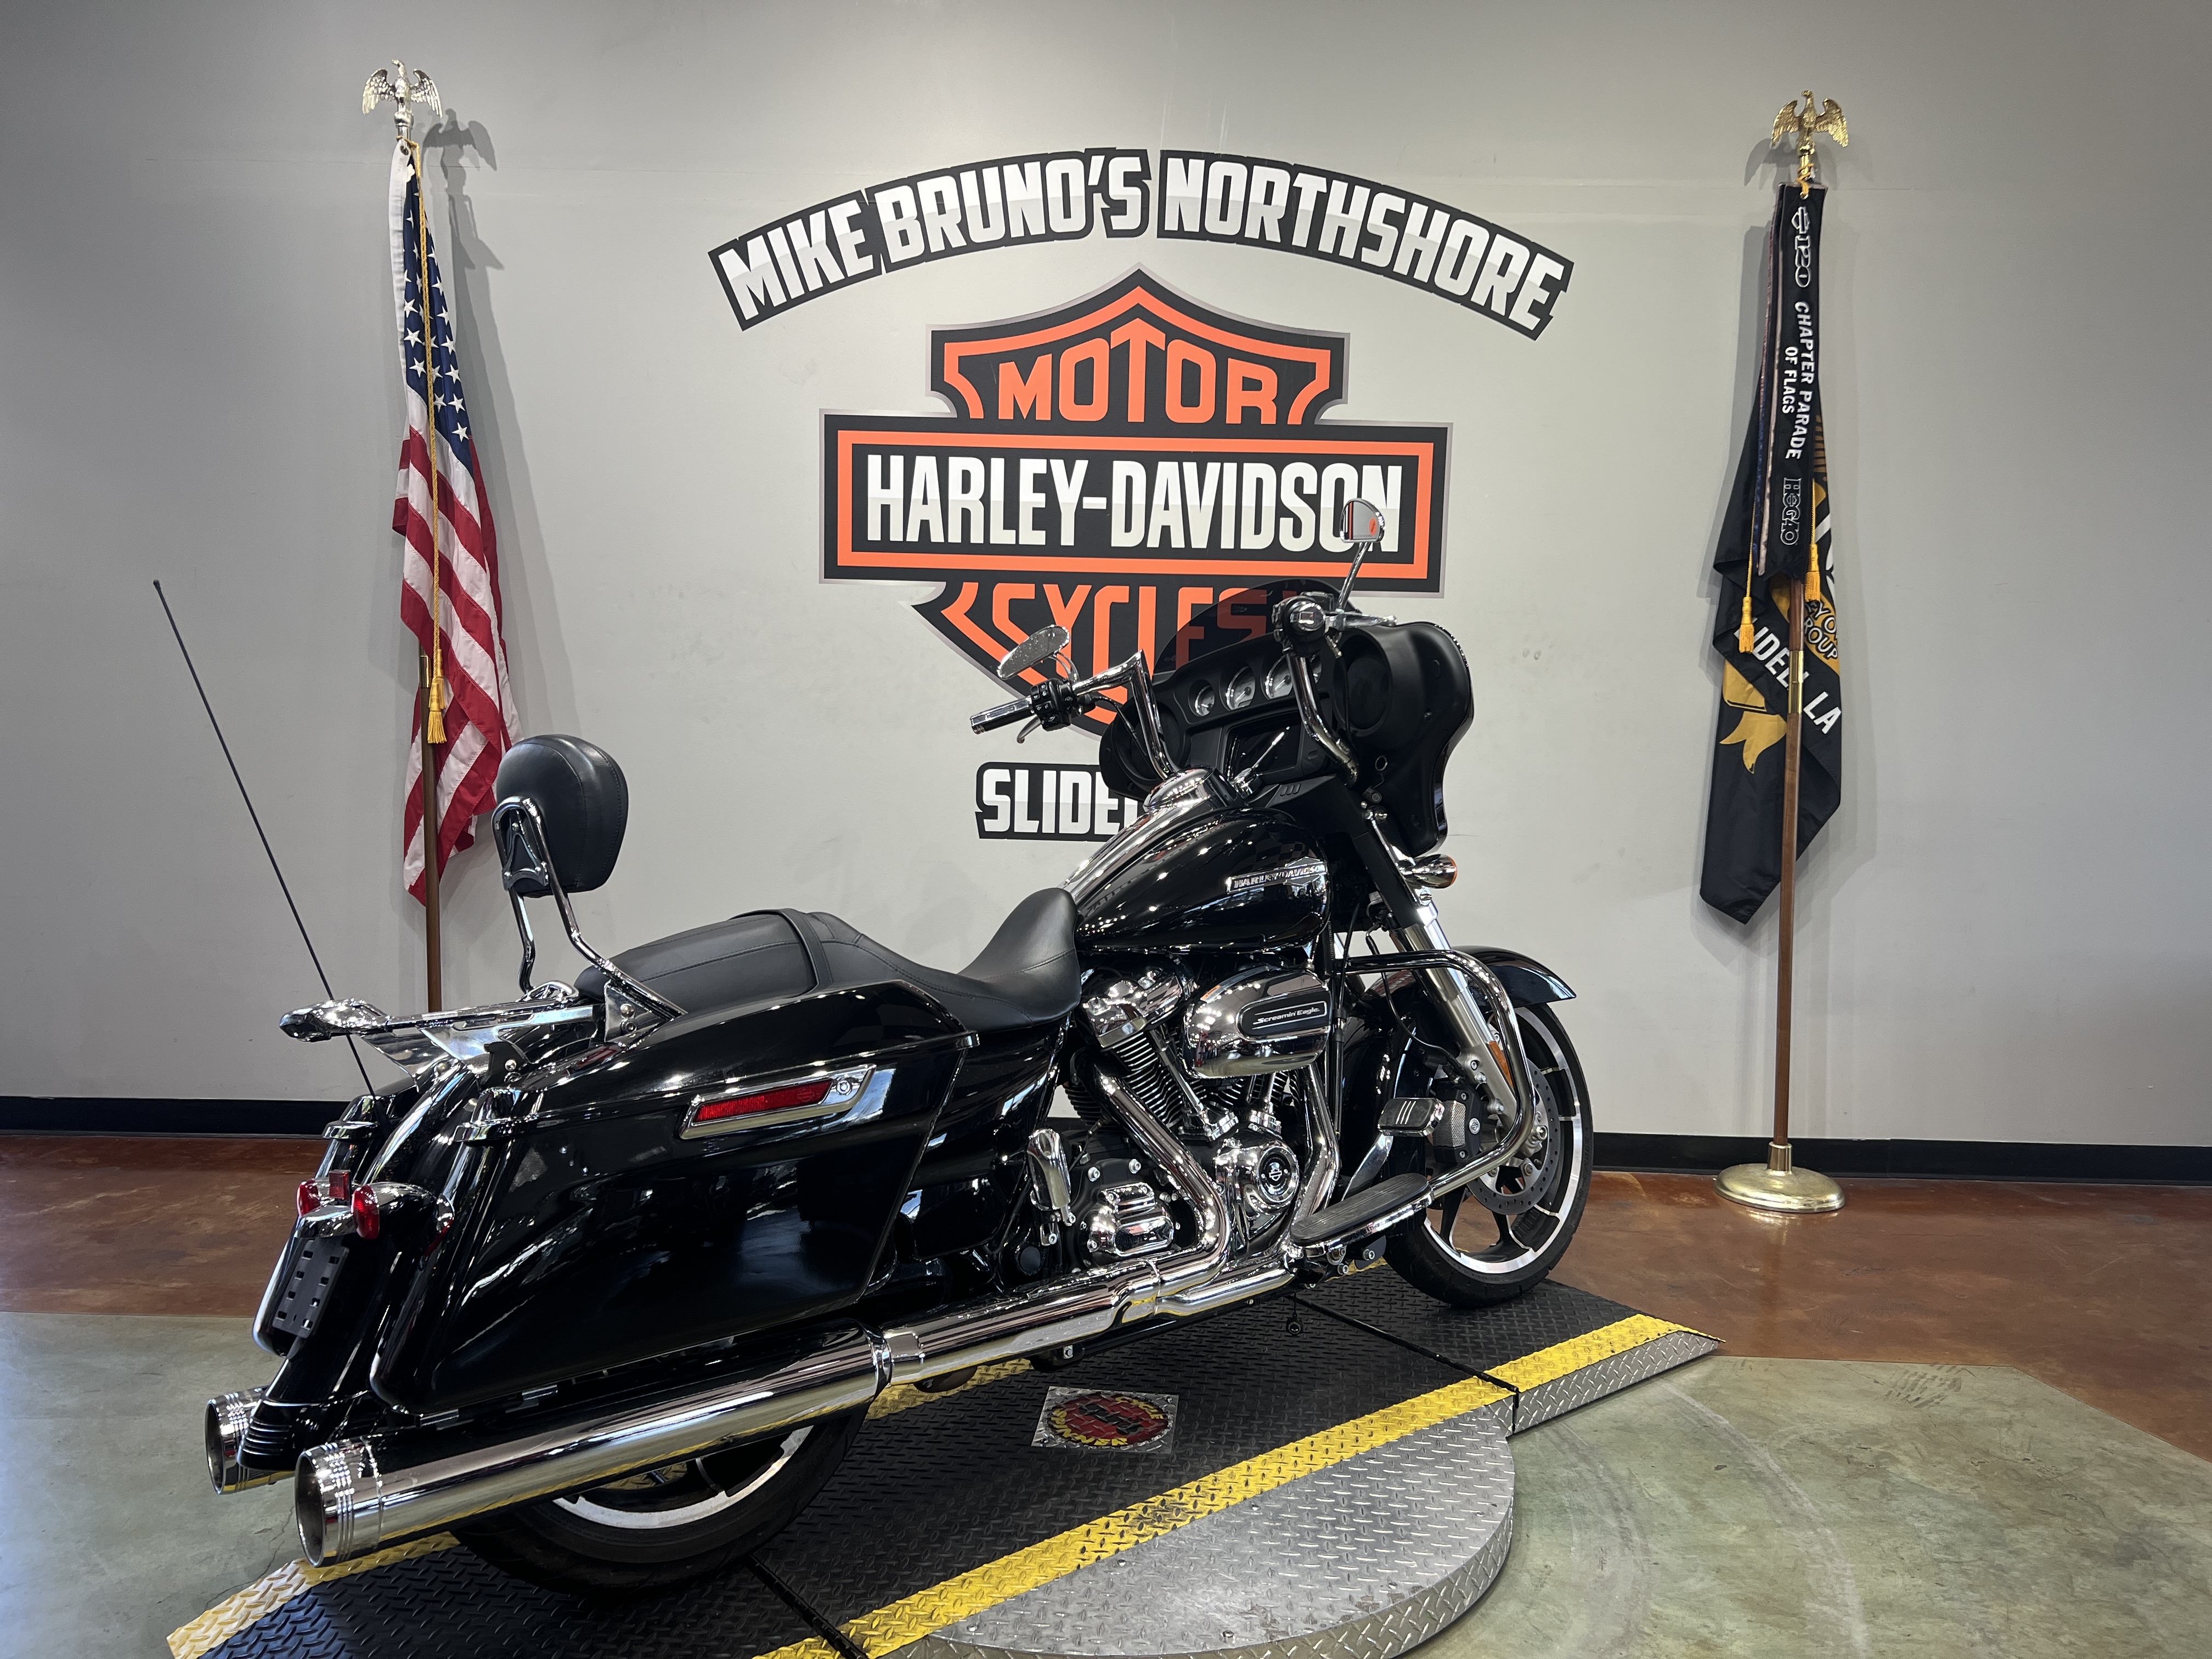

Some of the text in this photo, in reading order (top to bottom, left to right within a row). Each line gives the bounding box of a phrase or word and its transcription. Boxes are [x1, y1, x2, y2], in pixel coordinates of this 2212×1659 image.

[718, 155, 1565, 331] MIKE BRUNO'S NORTHSHORE
[998, 318, 1278, 425] MOTOR
[1781, 346, 1799, 415] OF FLAGS
[1785, 301, 1815, 460] CHAPTER PARADE
[867, 455, 1402, 552] HARLEY-DAVIDSON
[1804, 617, 1838, 658] ROUP
[1803, 691, 1841, 734] LA
[1234, 865, 1325, 888] HARLEY-DAVIDSON
[1252, 1007, 1321, 1025] Screamin' Eagle
[1115, 1396, 1164, 1419] CYCLE
